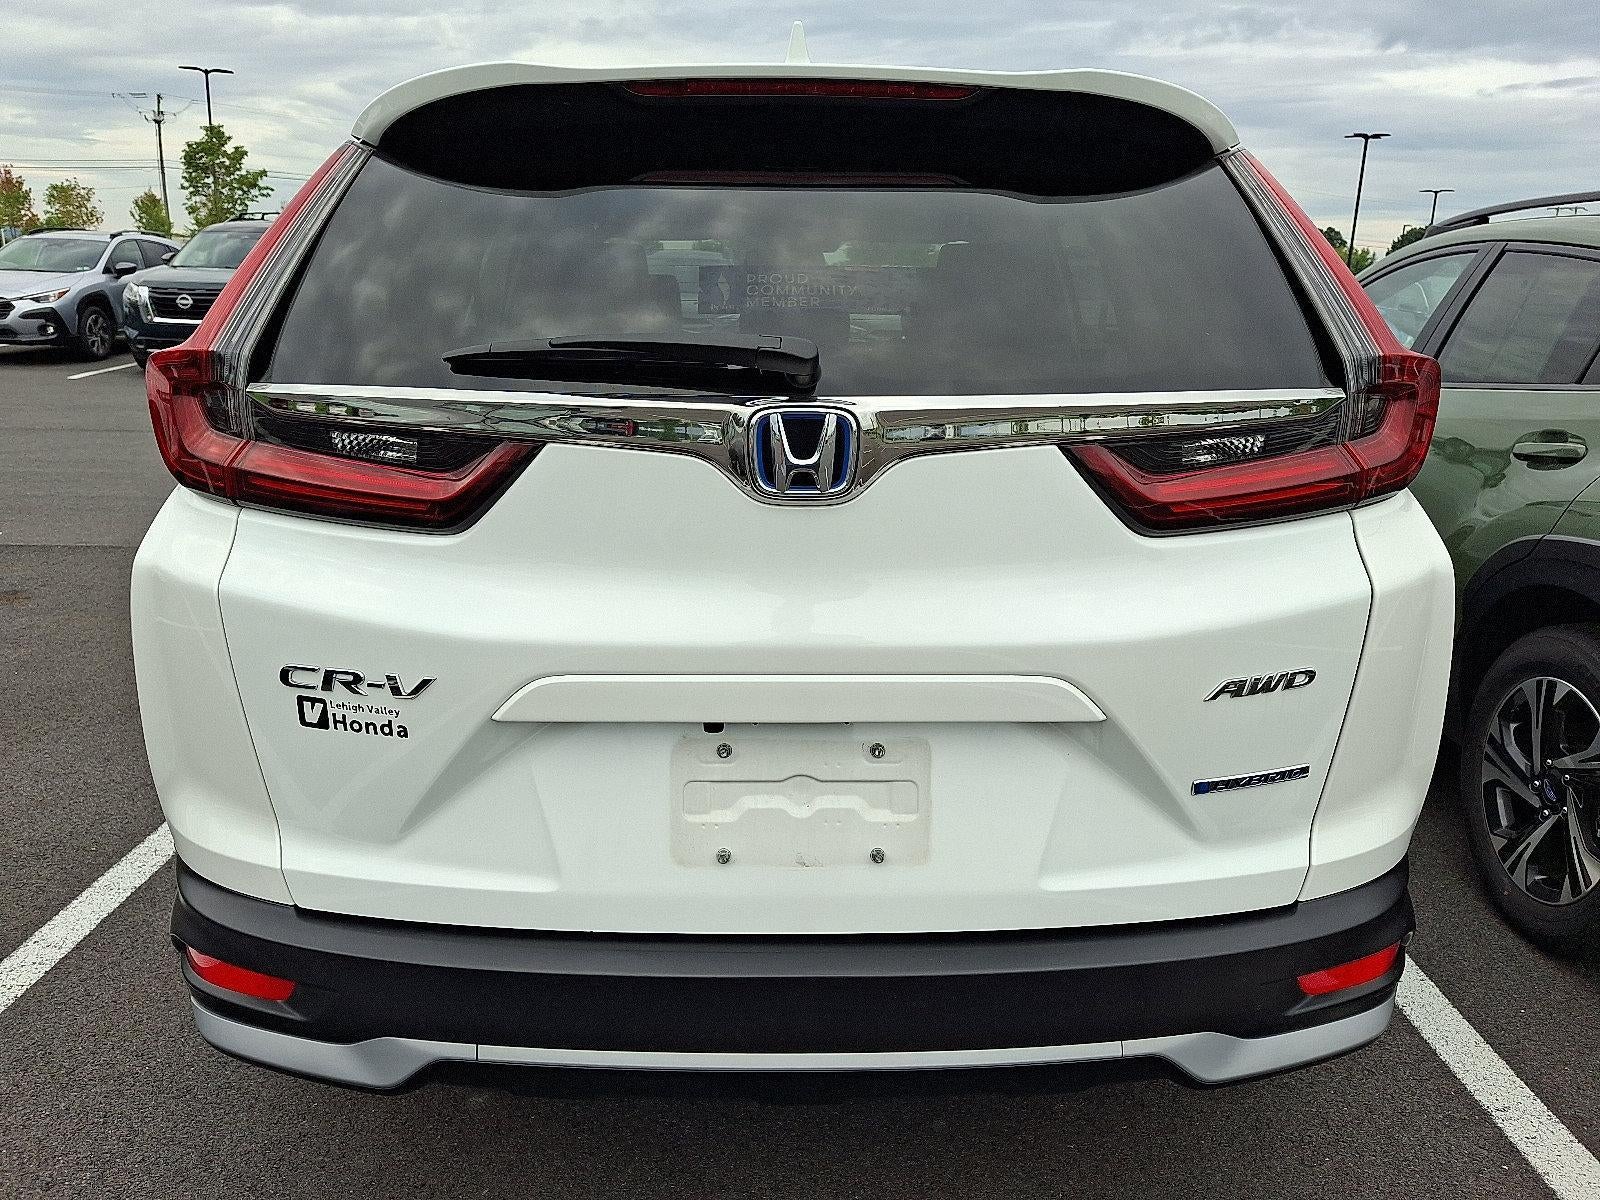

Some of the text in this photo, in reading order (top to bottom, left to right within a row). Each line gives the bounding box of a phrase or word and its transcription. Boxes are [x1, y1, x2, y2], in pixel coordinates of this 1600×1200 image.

[746, 273, 808, 284] PROUD
[746, 285, 858, 296] COMMUNITY
[746, 297, 821, 308] MEMBER
[279, 663, 438, 701] CR-V
[1202, 667, 1317, 702] AWD
[329, 700, 400, 718] Lehigh Valley
[331, 712, 409, 739] Honda
